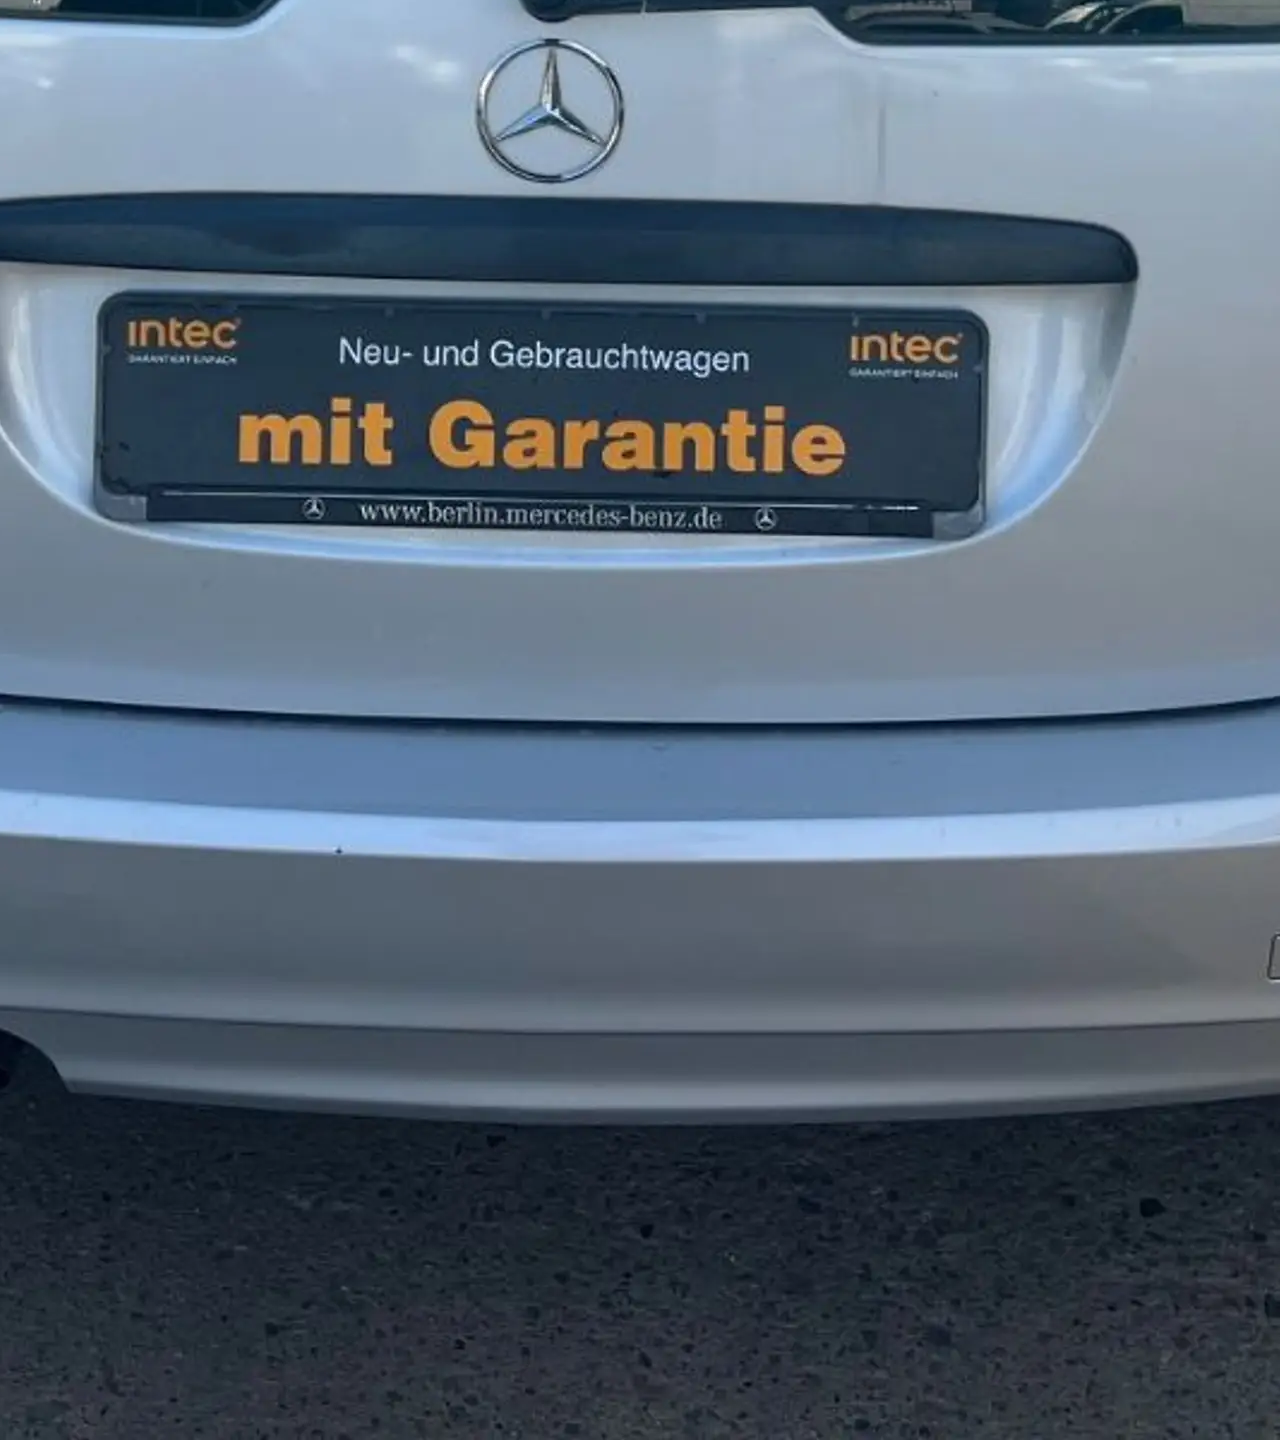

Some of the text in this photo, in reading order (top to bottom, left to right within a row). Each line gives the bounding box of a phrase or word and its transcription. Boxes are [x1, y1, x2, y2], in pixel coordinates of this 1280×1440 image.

[128, 316, 240, 350] intec
[850, 330, 963, 364] intec
[338, 335, 751, 378] Neu- und Gebrauchtwagen
[237, 396, 846, 476] mit Garantie
[359, 500, 723, 531] www.berlin.mercedes-benz.de
